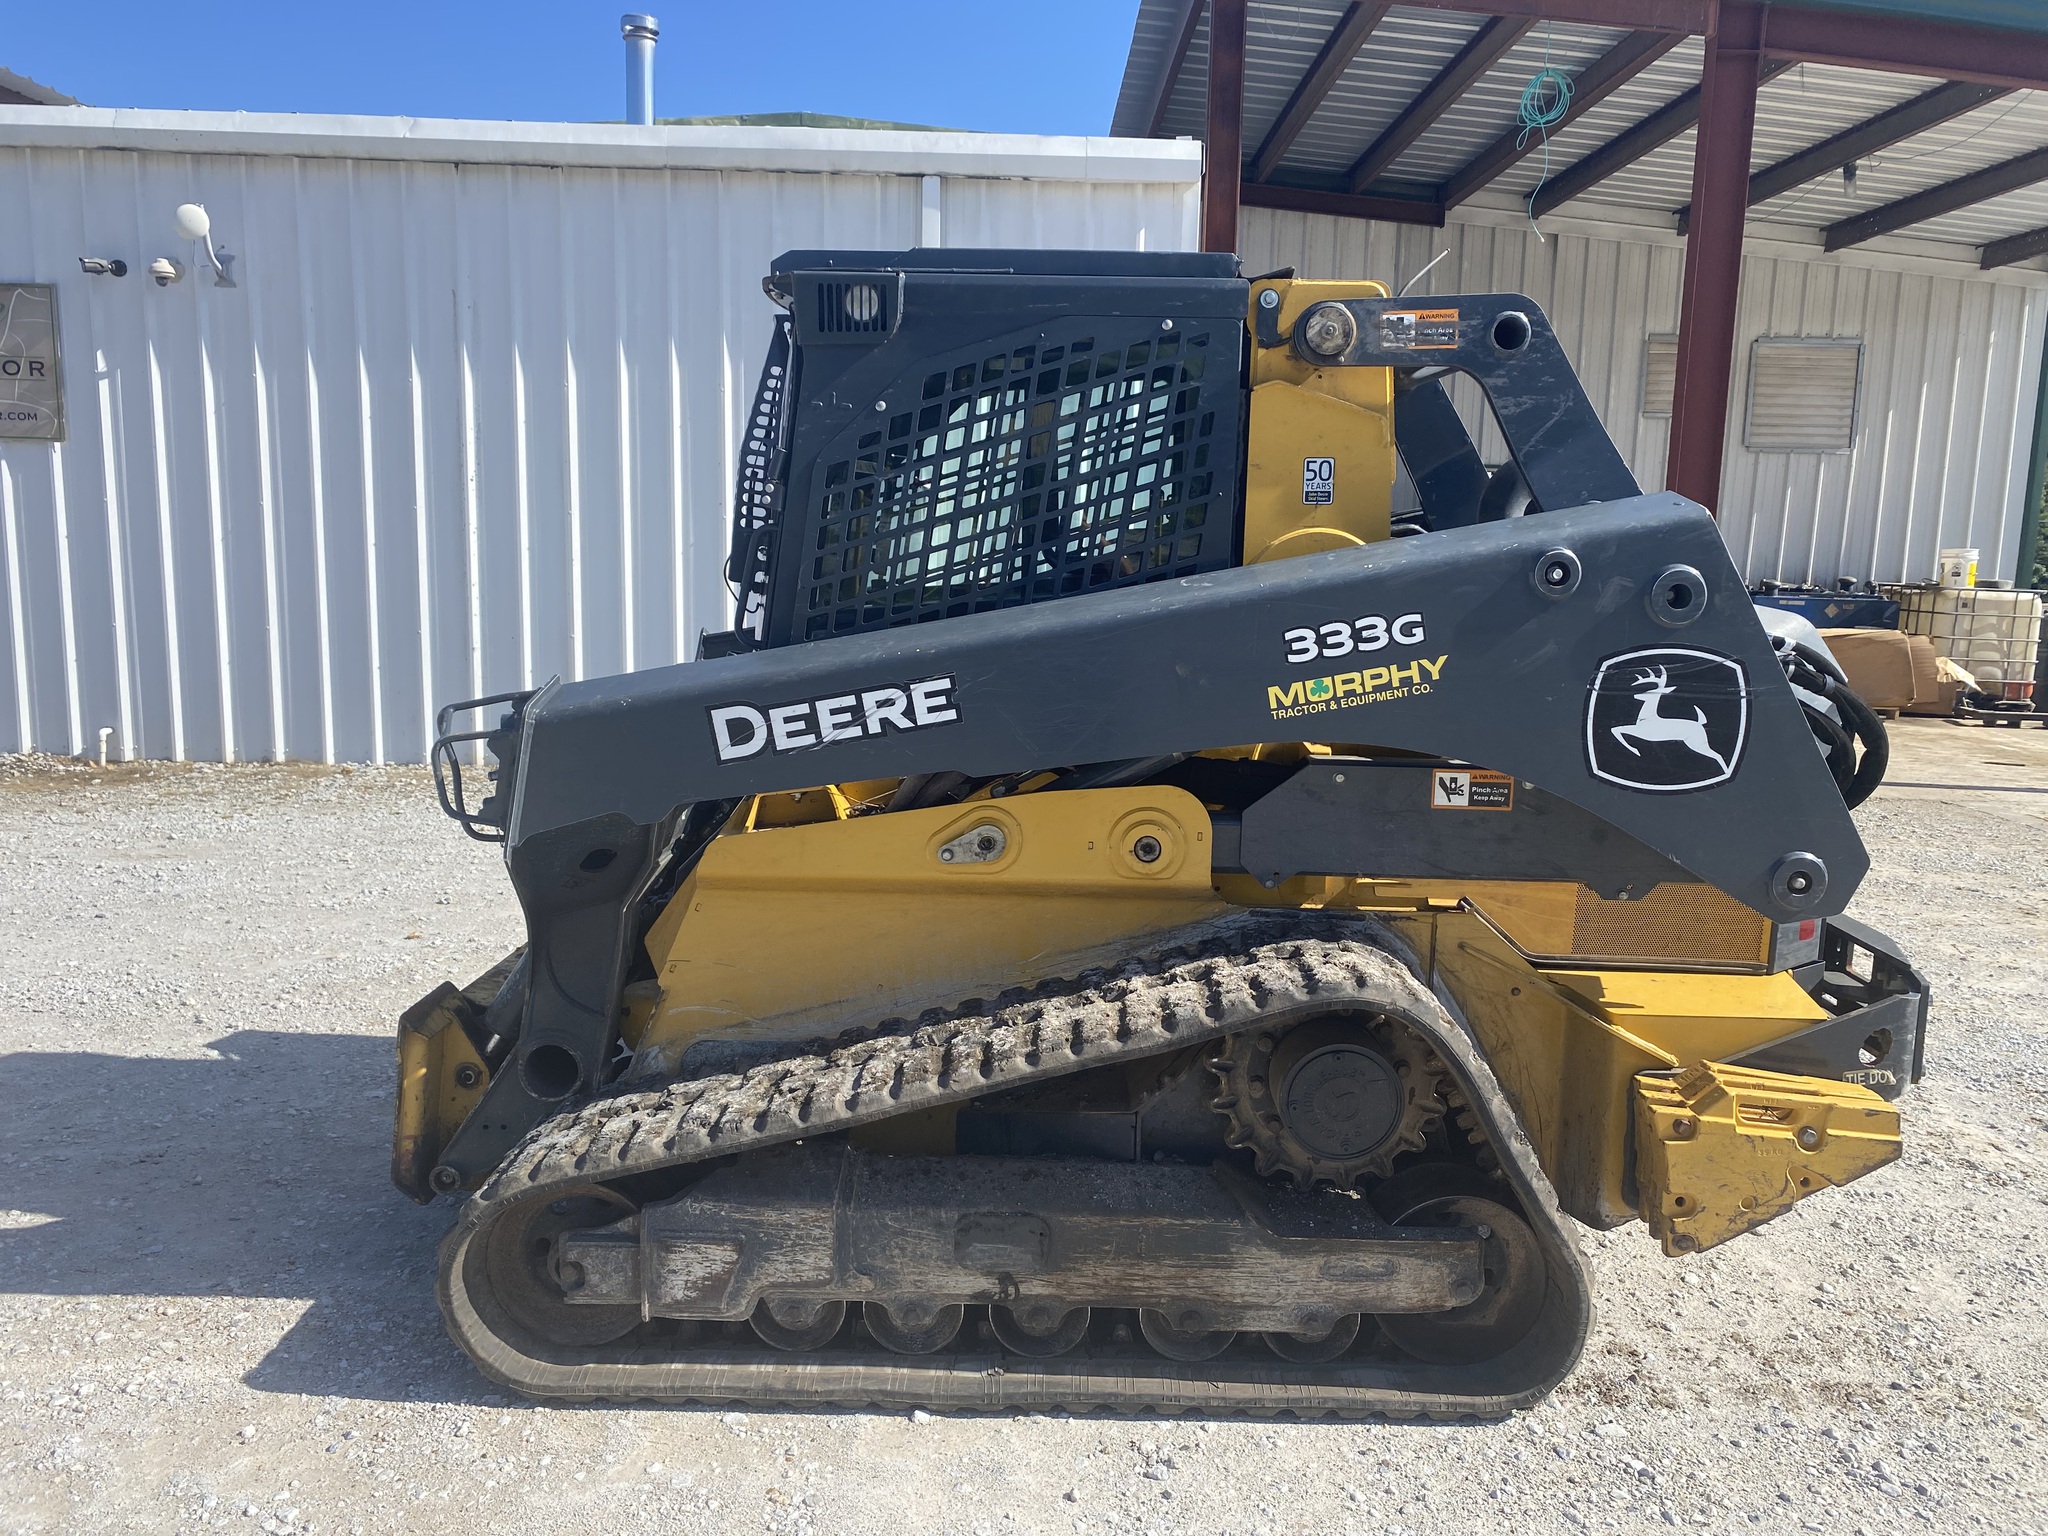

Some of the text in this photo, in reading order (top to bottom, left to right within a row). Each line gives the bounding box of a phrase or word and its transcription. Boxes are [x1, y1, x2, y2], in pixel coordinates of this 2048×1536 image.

[1305, 460, 1333, 482] 50
[1305, 482, 1332, 490] YEARS
[1284, 613, 1425, 663] 333G
[1267, 655, 1449, 709] MURPHY
[710, 678, 957, 760] DEERE
[1271, 683, 1434, 720] TRACTOR & EQUIPMENT CO.
[1846, 1072, 1866, 1085] TIE
